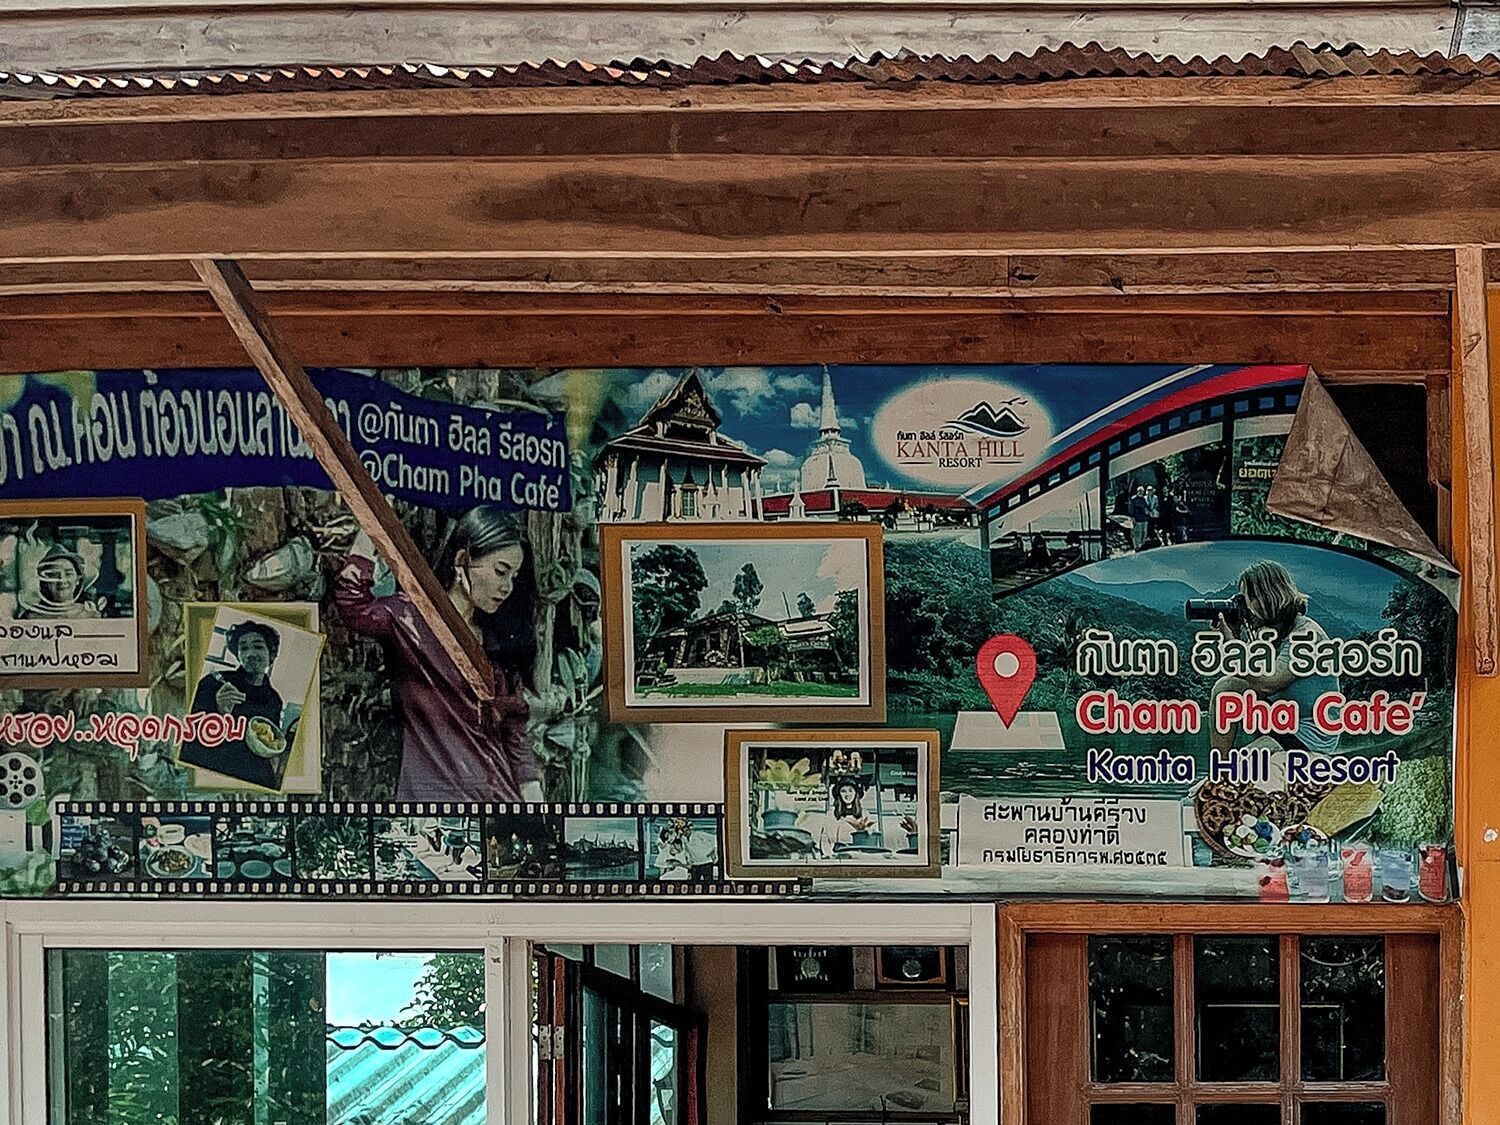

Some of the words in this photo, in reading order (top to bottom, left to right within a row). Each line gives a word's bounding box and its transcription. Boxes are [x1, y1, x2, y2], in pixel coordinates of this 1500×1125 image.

[896, 440, 969, 458] KANTA
[977, 440, 1025, 458] HILL
[938, 457, 983, 468] RESORT
[460, 465, 502, 501] Pha
[1076, 628, 1178, 677] กันตา
[1191, 628, 1278, 677] ฮิลล์
[1288, 627, 1423, 677] รีสอร์ท
[1076, 689, 1201, 736] Cham
[1216, 690, 1298, 735] Pha
[1086, 748, 1195, 784] Kanta
[1210, 748, 1271, 784] Hill
[1287, 749, 1402, 784] Resort
[1024, 824, 1120, 845] คลองท่าดี
